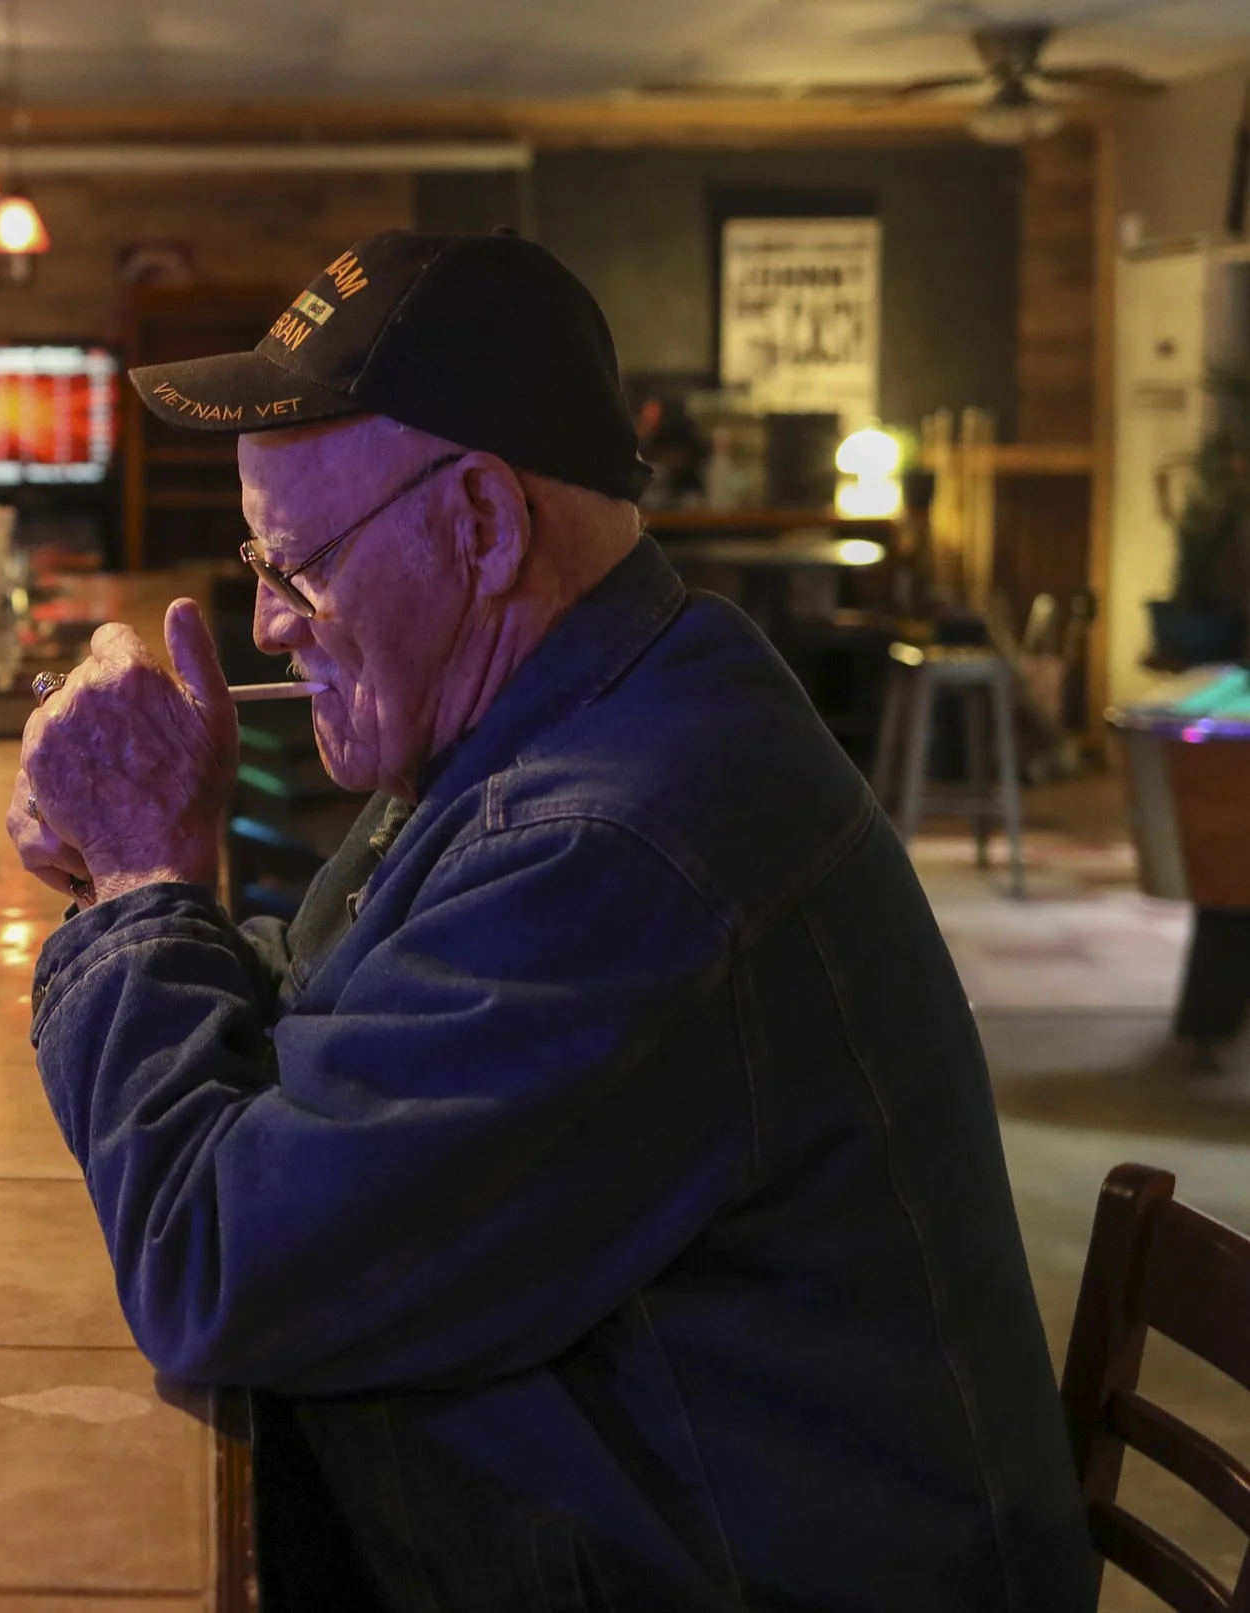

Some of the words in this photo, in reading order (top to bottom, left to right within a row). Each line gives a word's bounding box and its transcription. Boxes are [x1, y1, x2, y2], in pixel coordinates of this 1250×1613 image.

[270, 312, 312, 352] RAN
[153, 381, 243, 420] VIETNAM
[255, 397, 302, 417] VET
